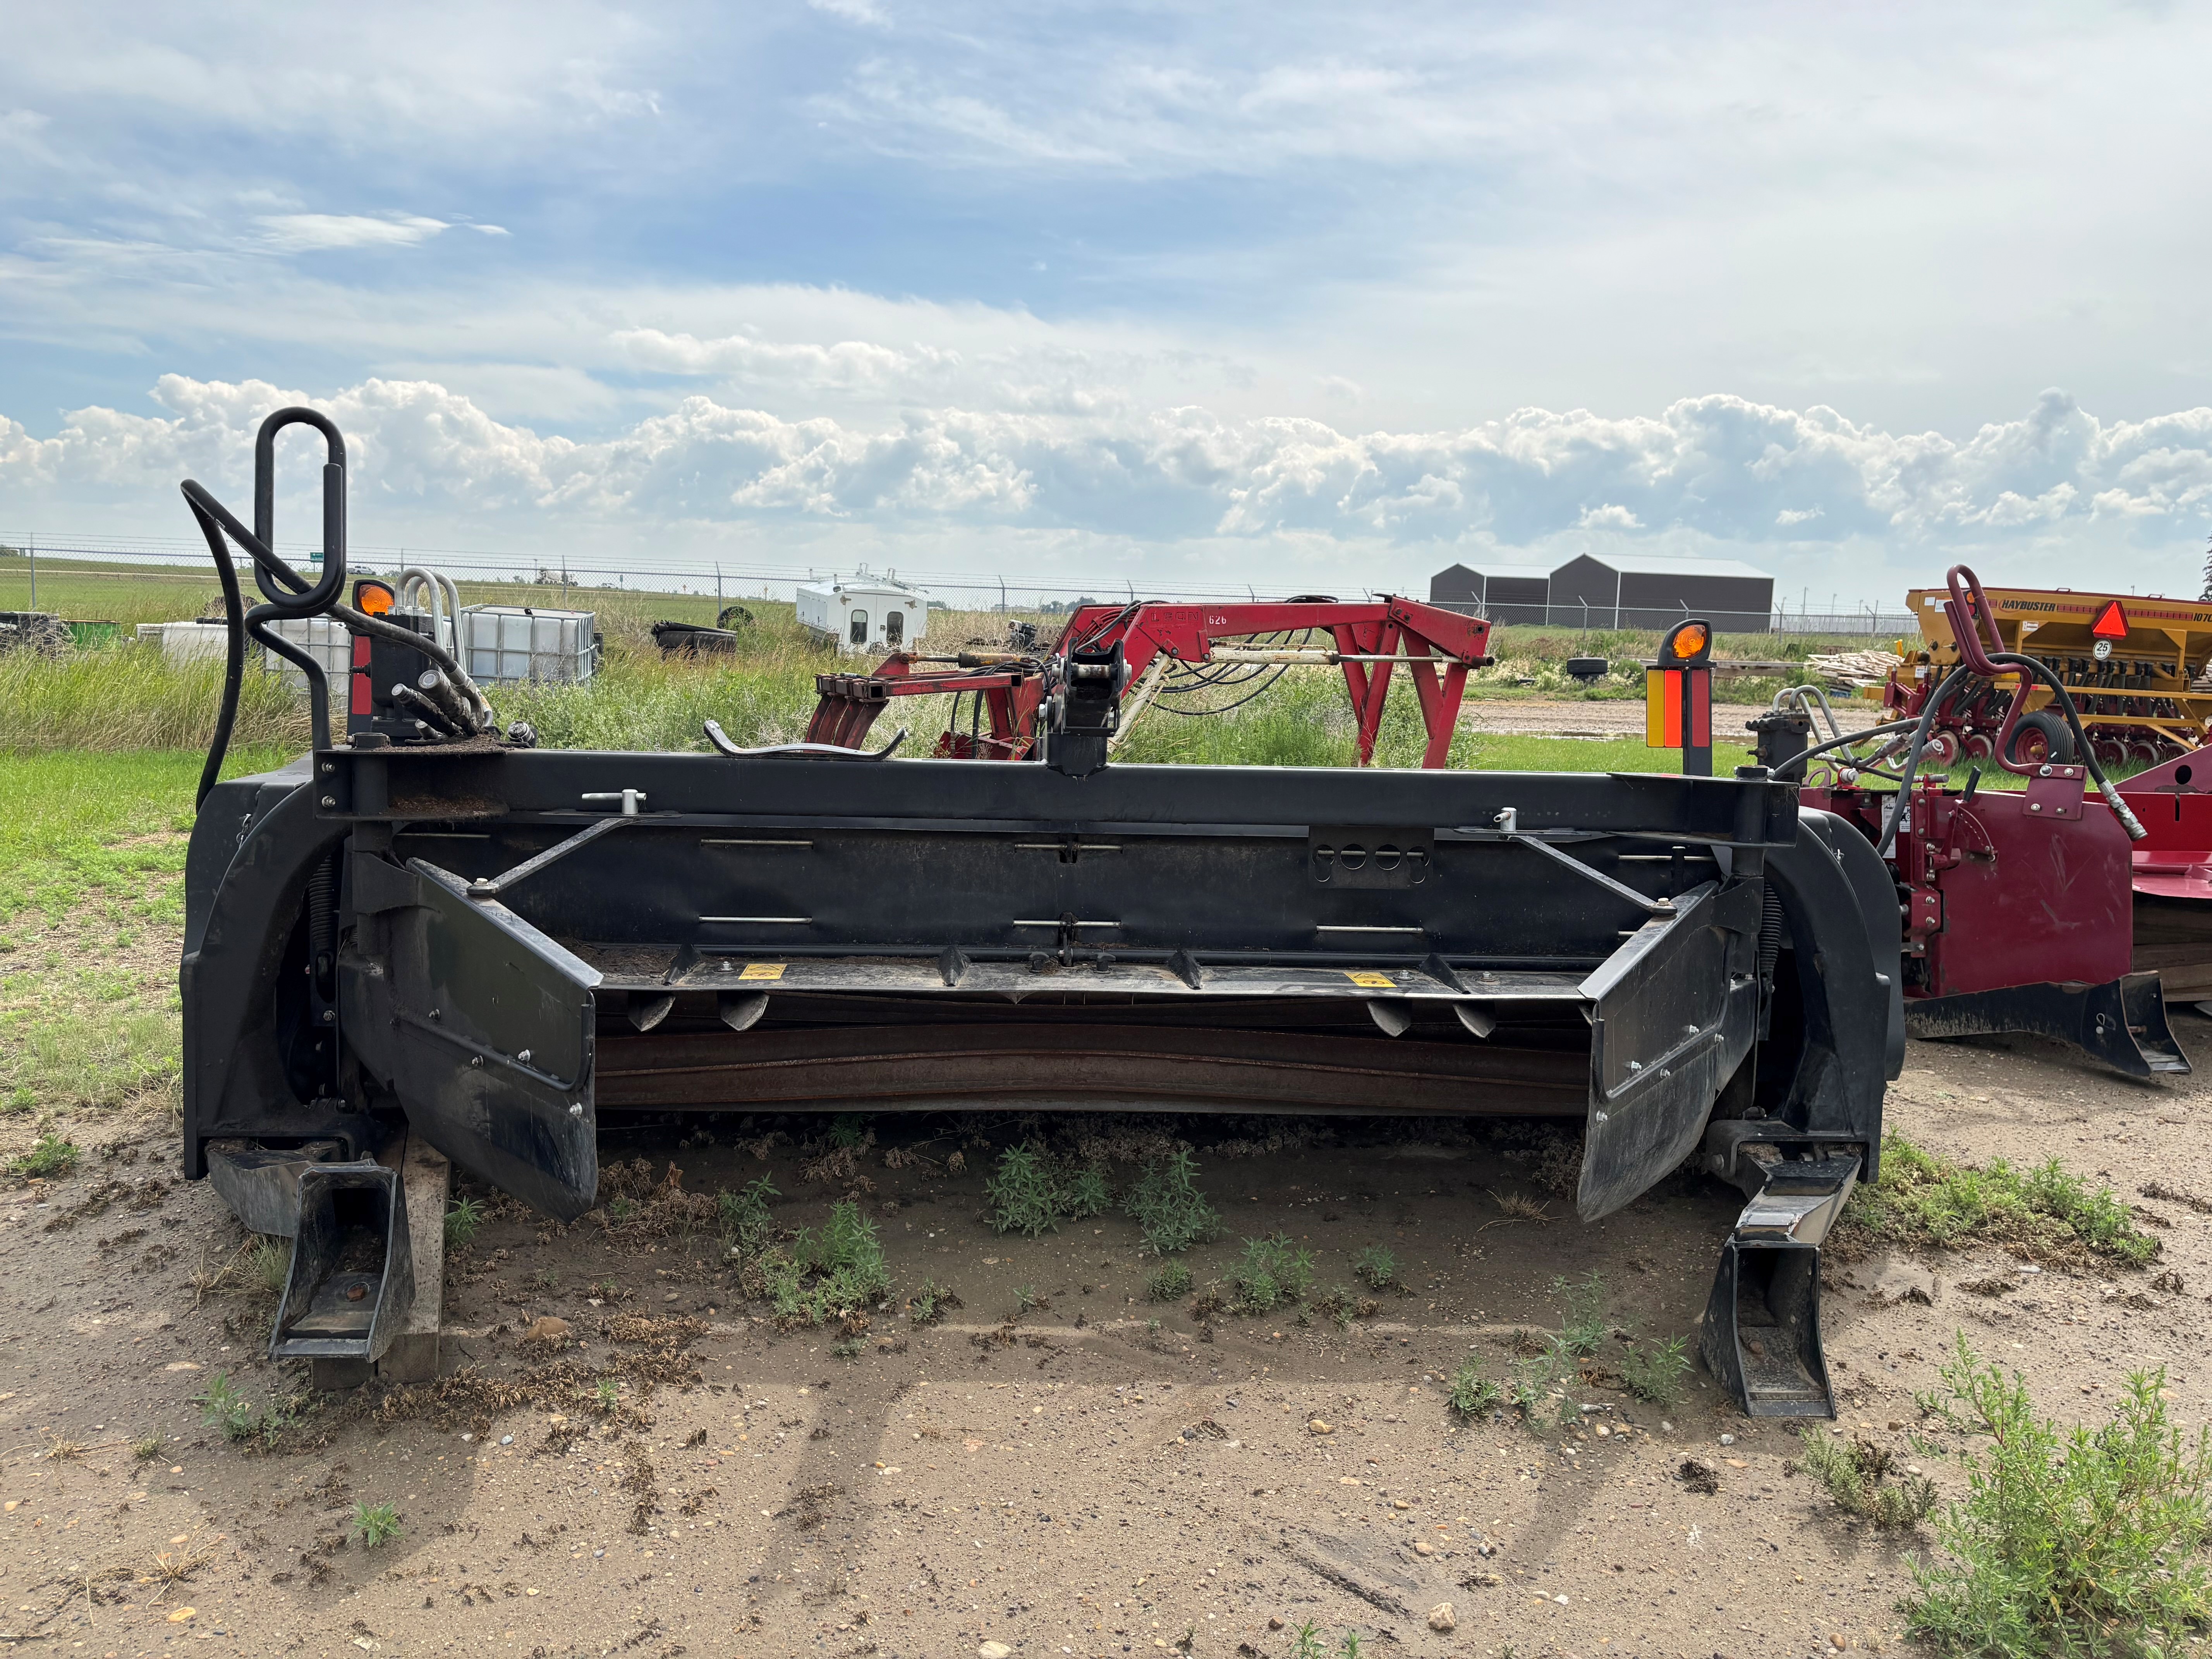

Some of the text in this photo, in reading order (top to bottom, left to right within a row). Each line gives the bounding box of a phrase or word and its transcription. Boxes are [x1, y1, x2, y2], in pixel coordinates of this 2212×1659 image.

[2001, 600, 2056, 612] HAYBUSTER
[1209, 615, 1227, 624] 626
[2097, 643, 2109, 652] 25
